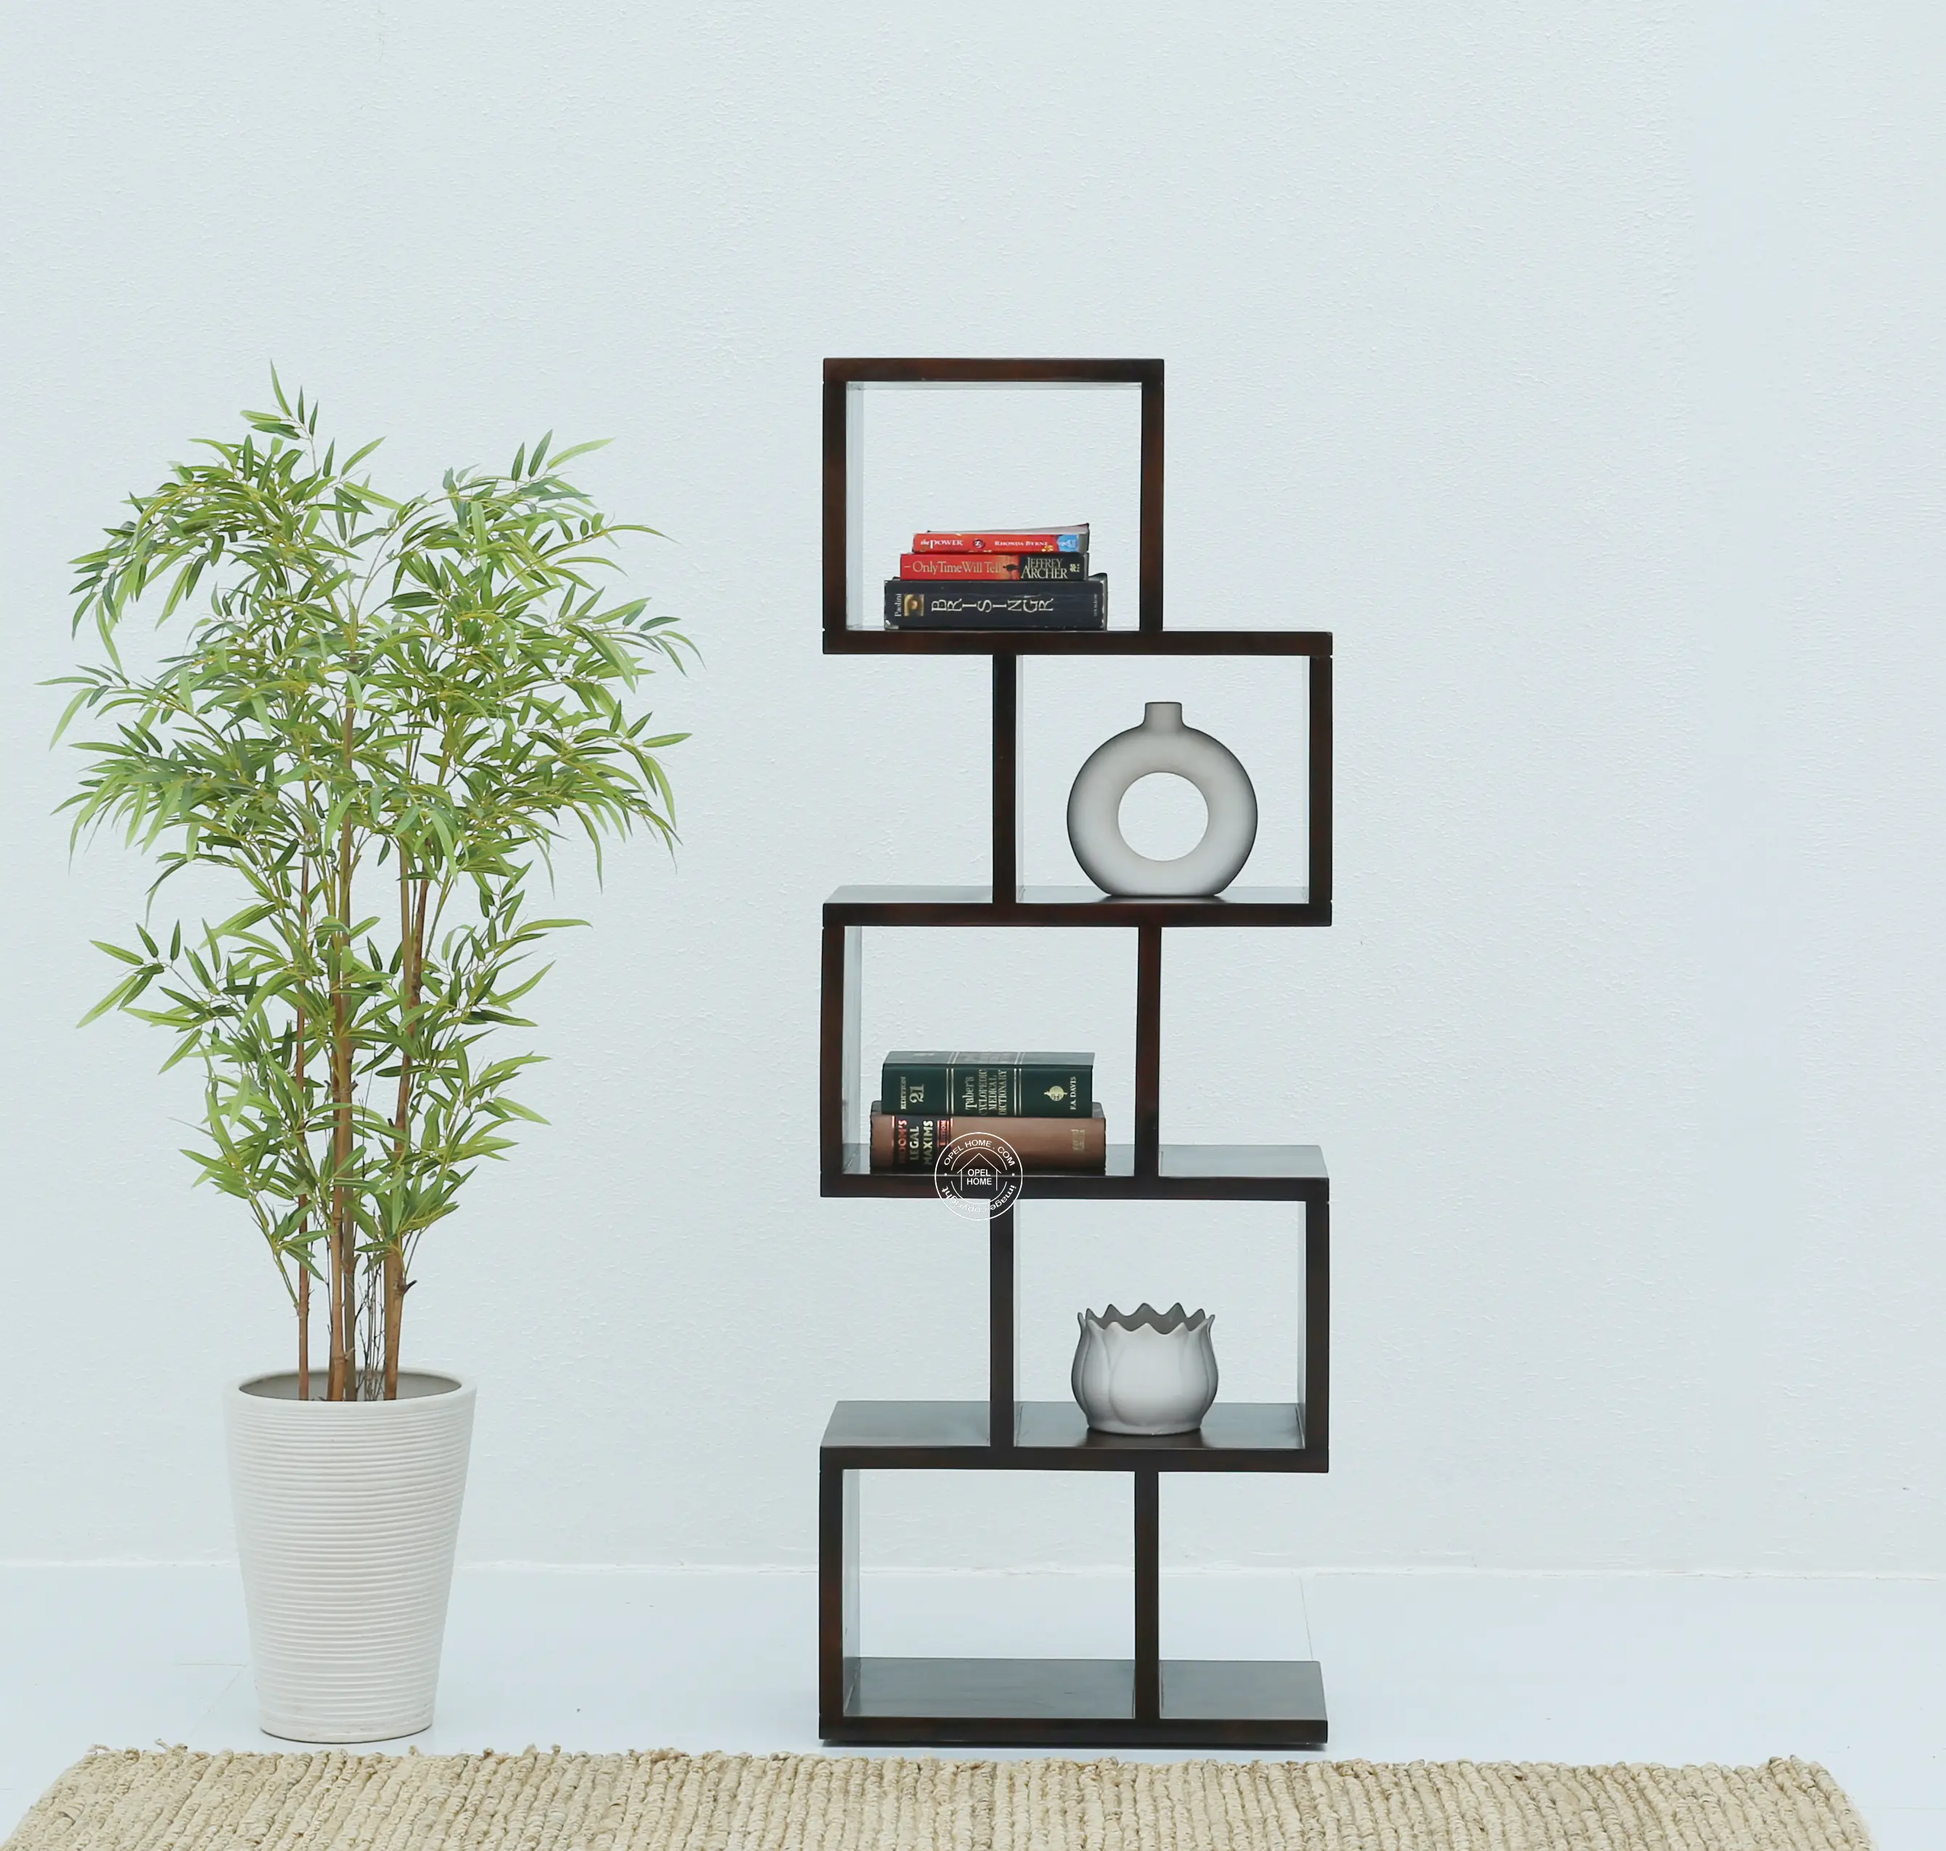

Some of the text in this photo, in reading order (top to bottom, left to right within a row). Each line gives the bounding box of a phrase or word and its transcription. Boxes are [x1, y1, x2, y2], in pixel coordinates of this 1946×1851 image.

[930, 540, 963, 549] POWER
[912, 560, 1001, 575] Only Time Will Tell
[1020, 565, 1068, 579] ARCHER
[1027, 557, 1063, 569] JEFFREY
[894, 593, 902, 617] Paolini
[931, 598, 1054, 613] BRISINGR
[908, 1084, 925, 1104] 21
[962, 1076, 978, 1110] Taber's
[978, 1069, 988, 1116] CYCLOPEDIC
[988, 1075, 997, 1110] MEDICAL
[998, 1069, 1007, 1116] DICTIONARY
[909, 1126, 919, 1160] LEGAL
[922, 1120, 933, 1165] MAXIMS
